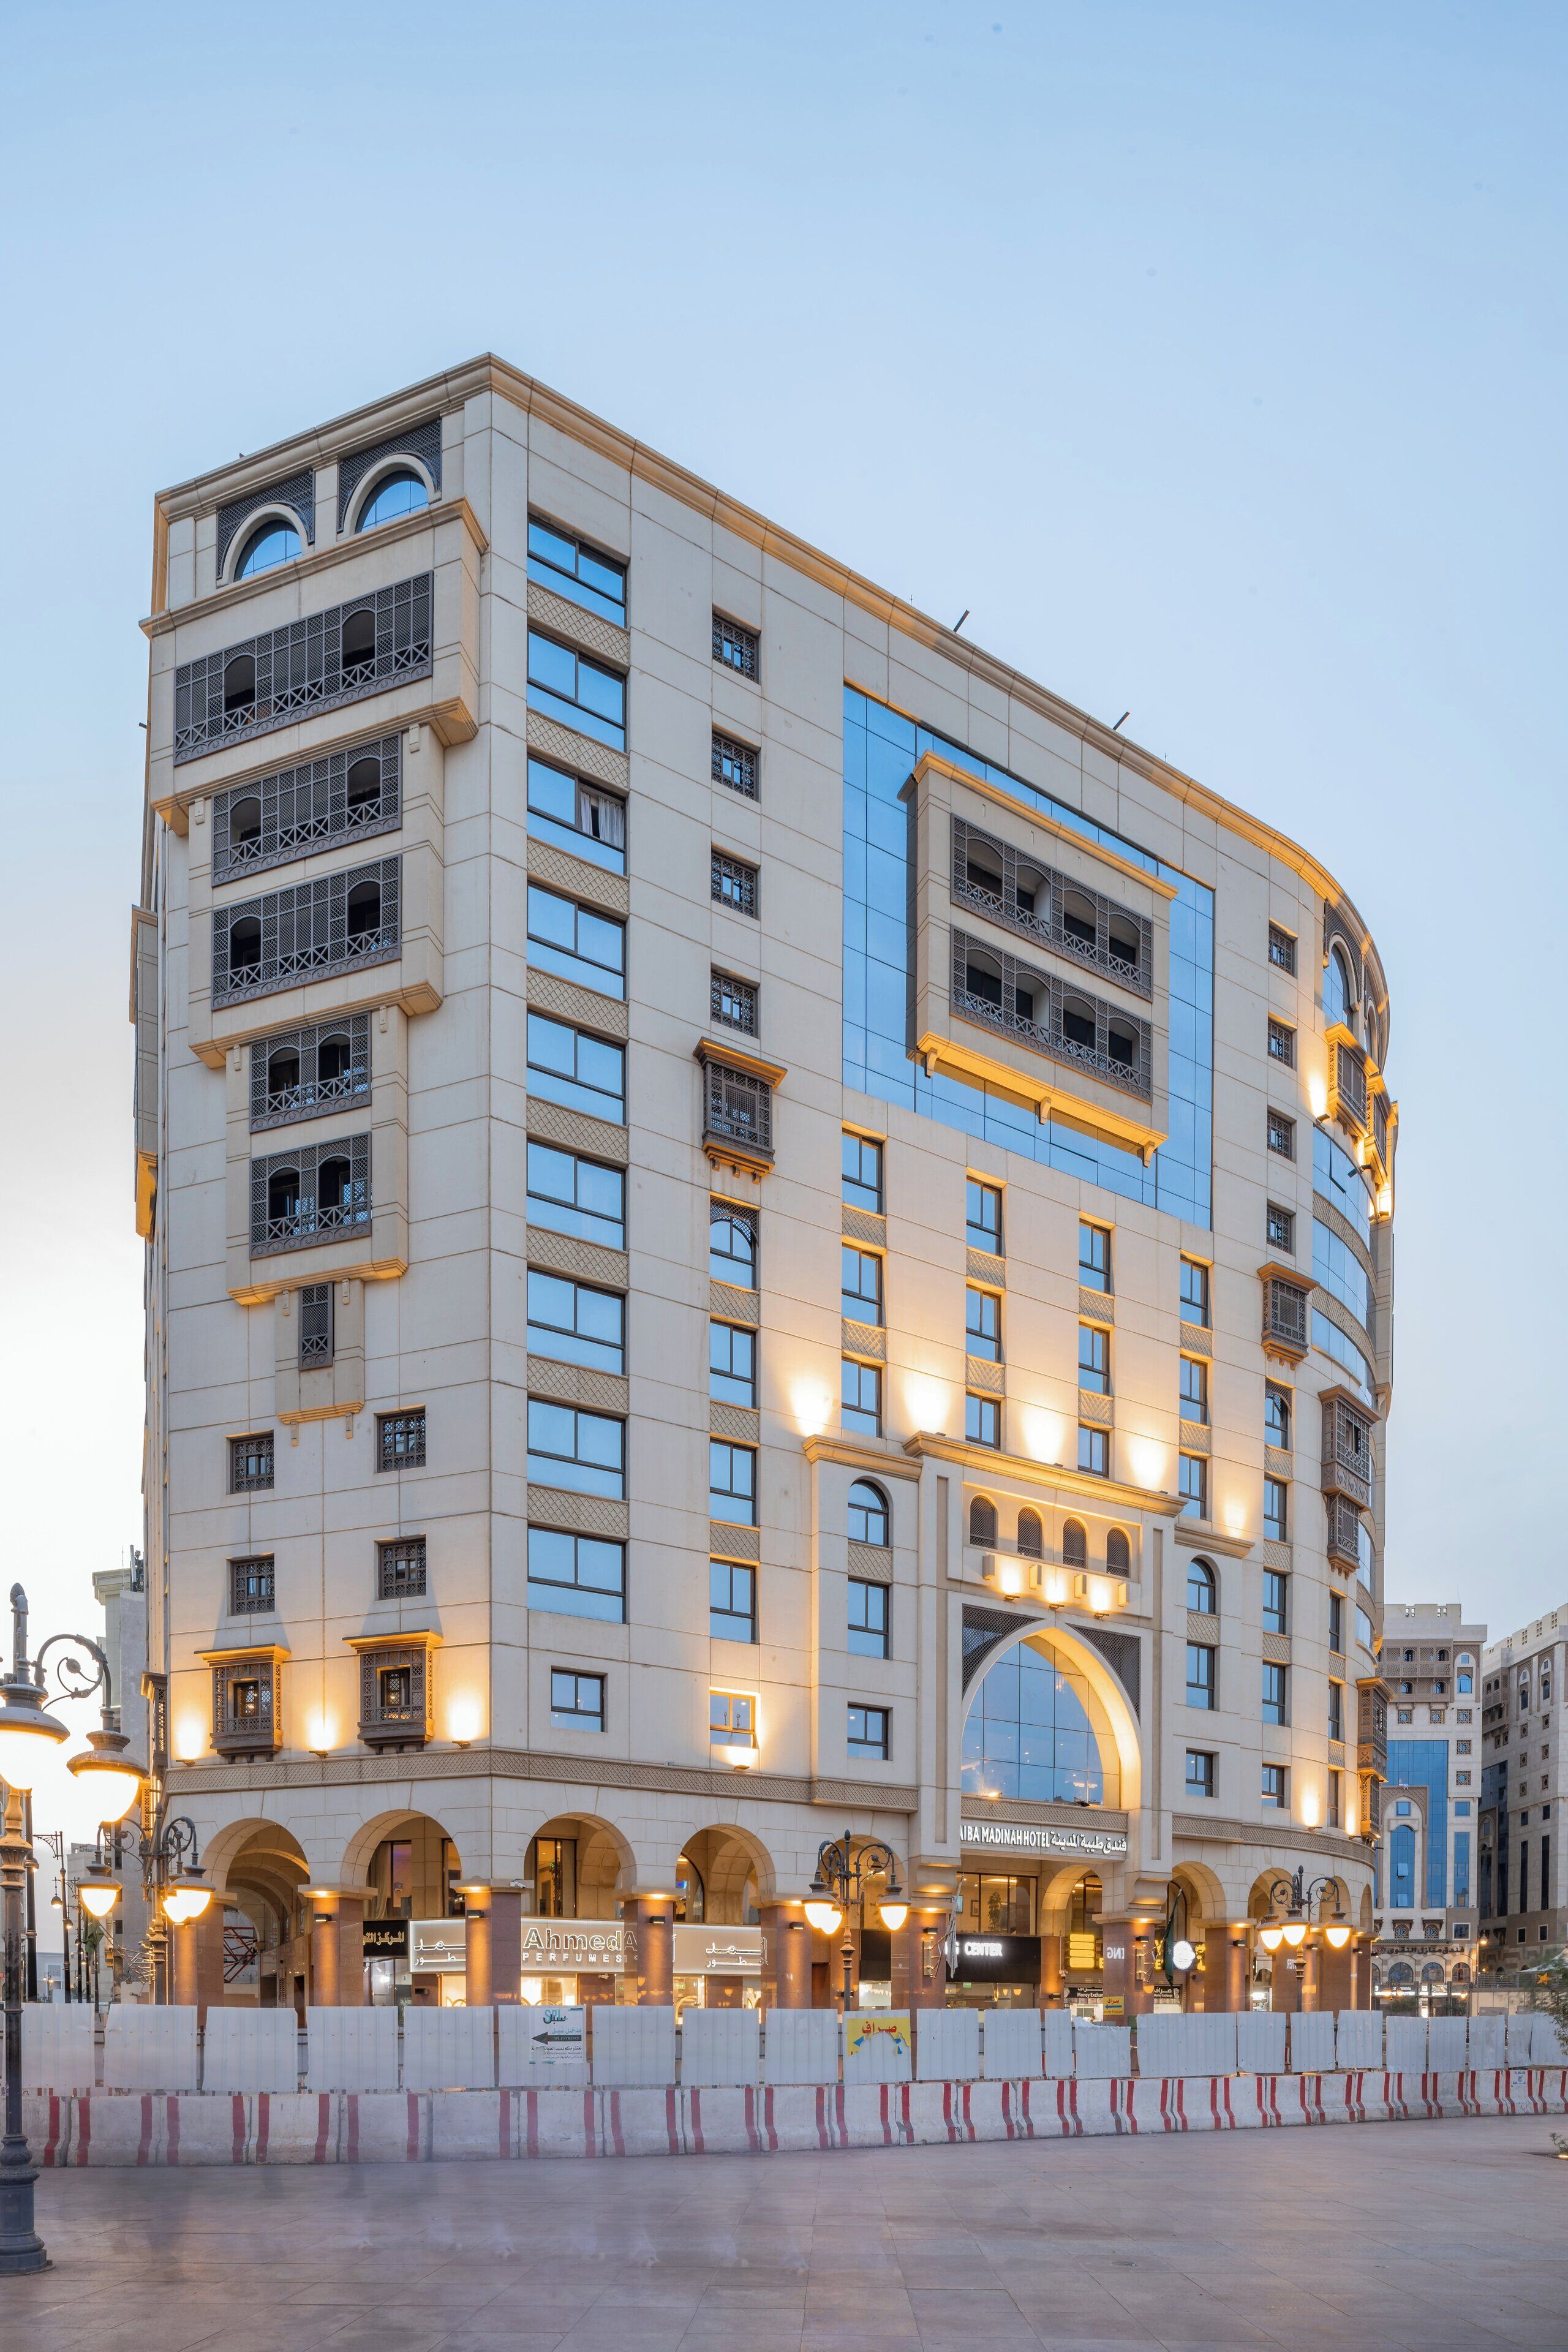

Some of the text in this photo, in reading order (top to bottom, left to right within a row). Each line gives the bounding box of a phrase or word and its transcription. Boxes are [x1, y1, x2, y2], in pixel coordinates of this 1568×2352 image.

[981, 1827, 1022, 1845] MADINAH
[1023, 1830, 1050, 1847] HOTEL
[1050, 1831, 1127, 1854] فندق طيبة المدينة
[376, 1931, 405, 1946] المركز
[522, 1928, 622, 1951] Ahmed
[965, 1942, 1003, 1956] CENTER
[522, 1952, 622, 1963] PERFUMES
[862, 2021, 897, 2034] صراف
